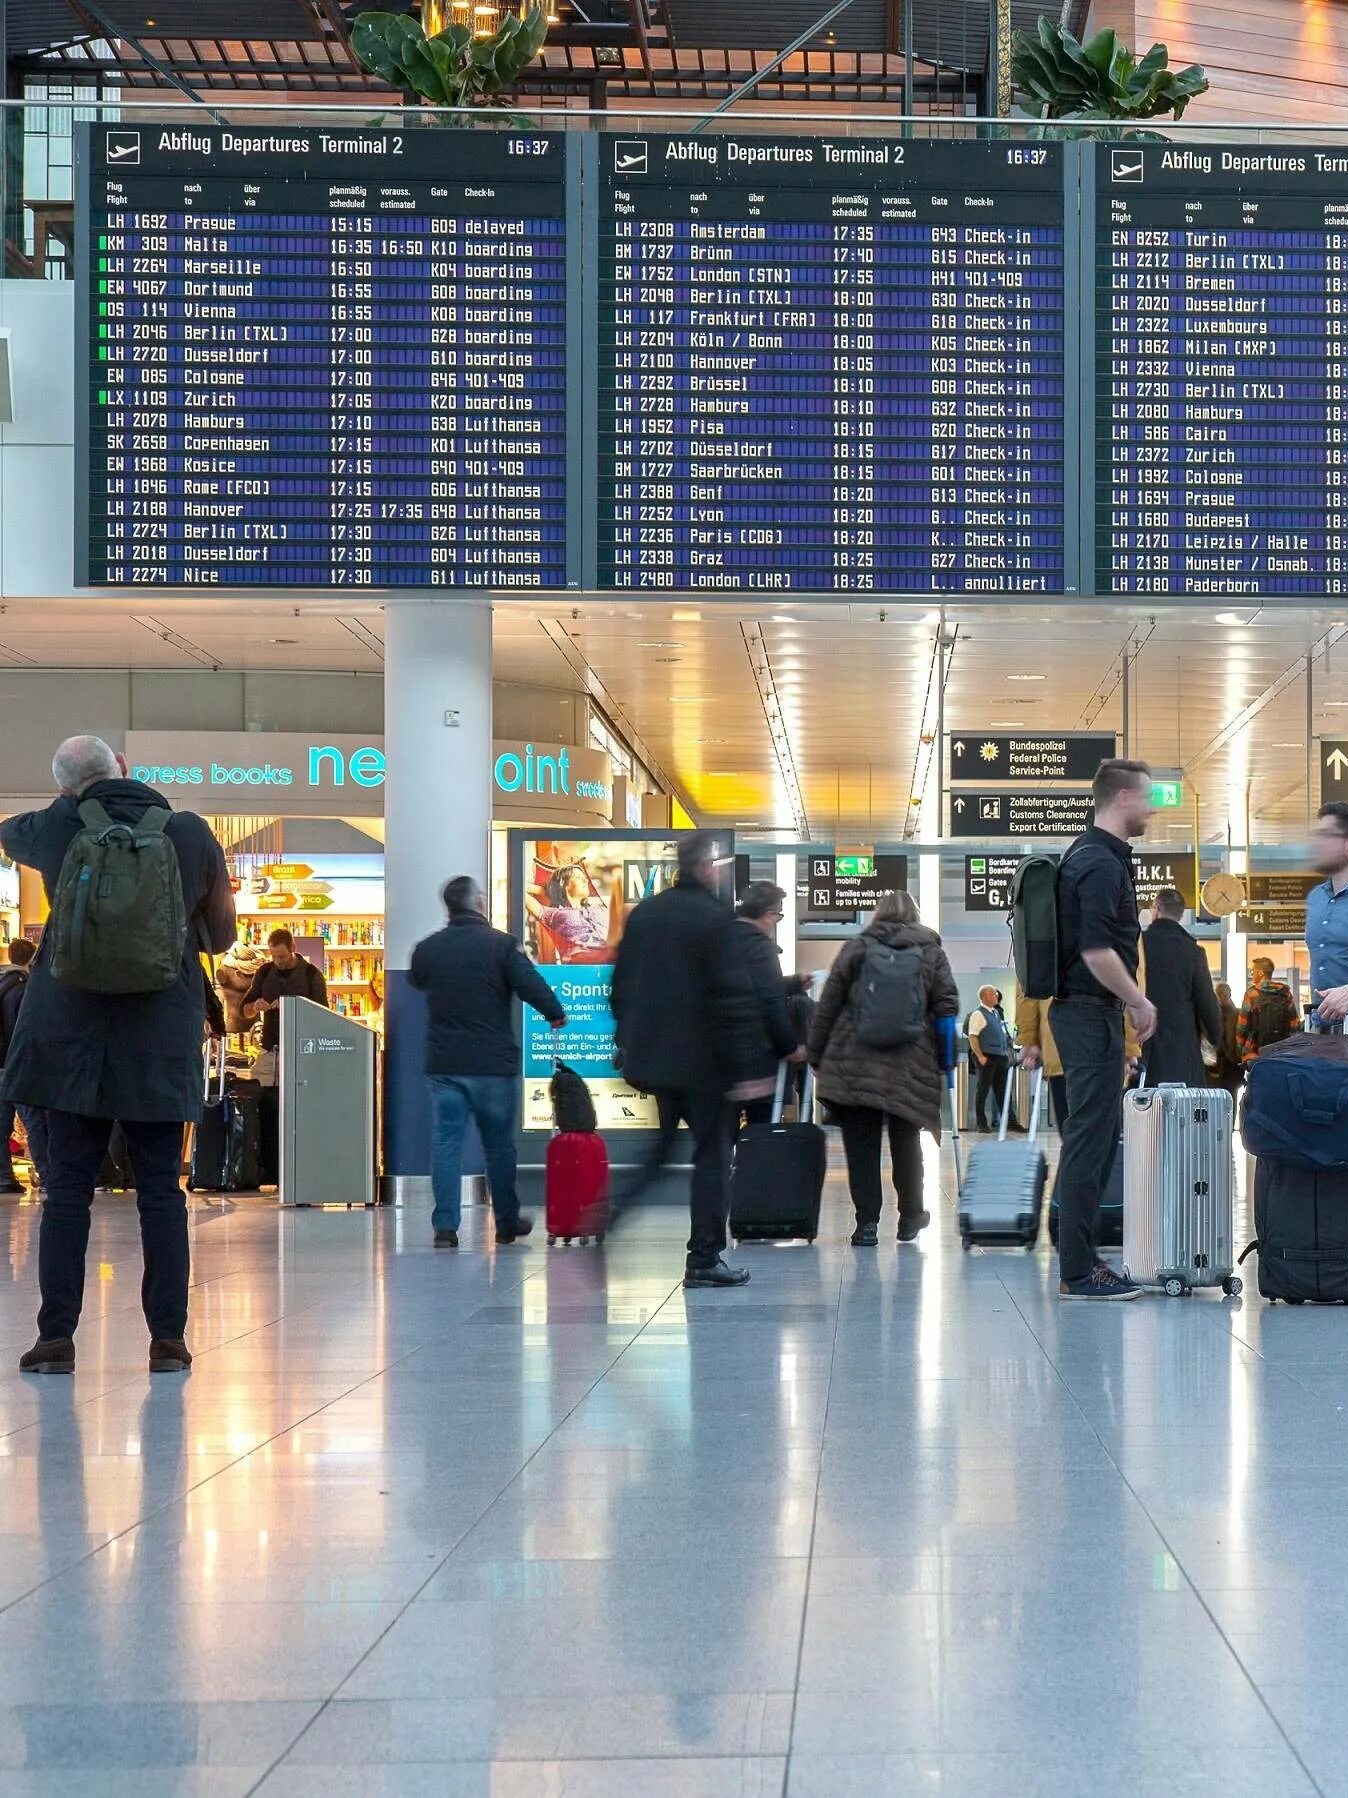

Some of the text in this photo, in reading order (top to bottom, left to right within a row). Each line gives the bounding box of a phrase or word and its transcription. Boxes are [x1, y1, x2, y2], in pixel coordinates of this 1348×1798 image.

[158, 132, 403, 156] Abflug Departures Terminal 2
[508, 140, 549, 155] 16:37
[665, 141, 905, 165] Abflug Departures Terminal 2
[1007, 149, 1047, 165] 16:37
[1160, 151, 1212, 174] Abflug
[1221, 152, 1306, 174] Departures
[106, 181, 123, 193] Flug
[183, 183, 202, 193] nach
[243, 184, 261, 194] über
[380, 188, 411, 196] vorauss.
[430, 187, 448, 197] Gate
[106, 194, 416, 209] Flight to via scheduled estimated
[107, 235, 533, 257] KM 309 Malta 16:35 16:50 K10 boarding
[1112, 273, 1129, 289] LH
[1136, 274, 1170, 289] 2114
[1185, 275, 1235, 291] Bremen
[615, 352, 1031, 374] LH 2100 Hannover 18:05 K03 Check-in
[107, 390, 533, 411] LX 1109 Zurich 17:05 K20 boarding
[1009, 740, 1066, 752] Bundespolizei
[1009, 753, 1067, 763] Federal Police
[132, 765, 204, 785] press
[210, 763, 292, 785] books
[1009, 765, 1065, 776] Service-Point
[1009, 809, 1088, 820] Customs Clearance/
[1009, 822, 1087, 833] Export Certification
[835, 877, 861, 885] mobility
[989, 878, 1007, 886] Gates
[845, 898, 852, 906] to
